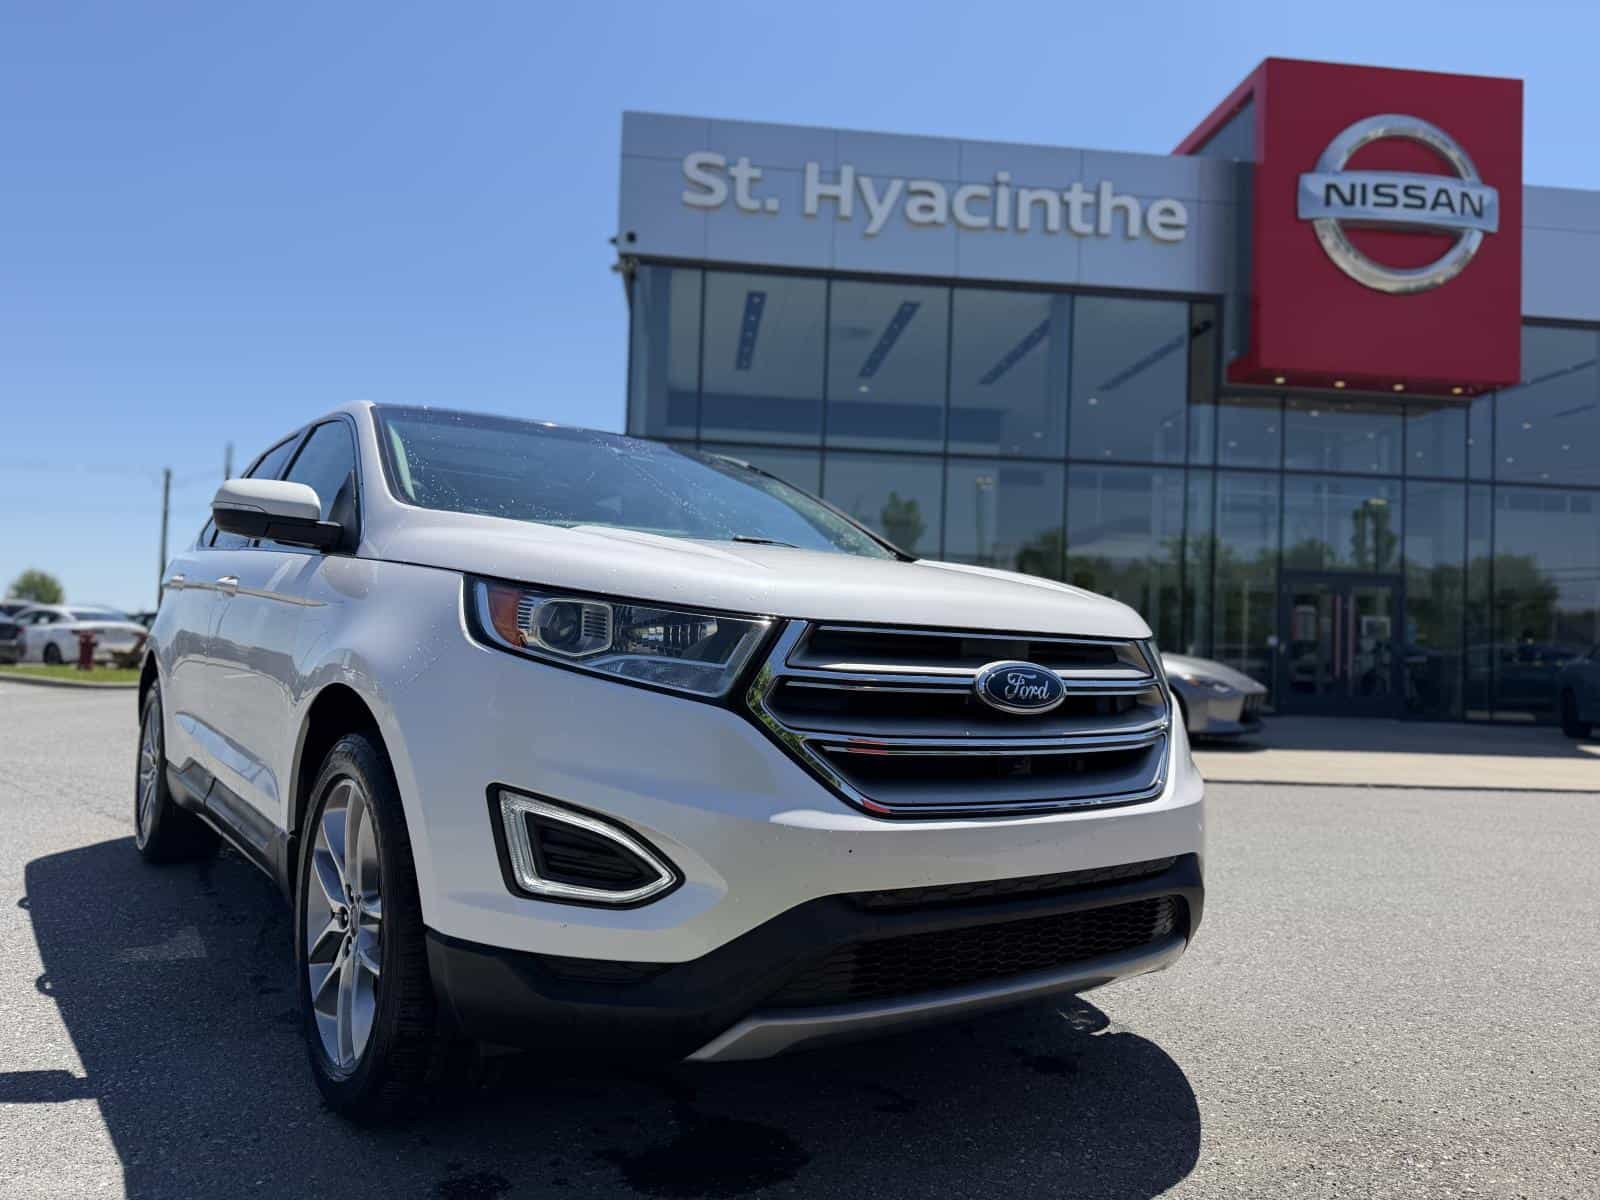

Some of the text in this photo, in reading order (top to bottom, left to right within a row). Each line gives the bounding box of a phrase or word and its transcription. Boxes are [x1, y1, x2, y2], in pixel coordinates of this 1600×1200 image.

[682, 152, 1188, 241] St. Hyacinthe
[1324, 183, 1484, 219] NISSAN
[1005, 672, 1050, 699] Ford
